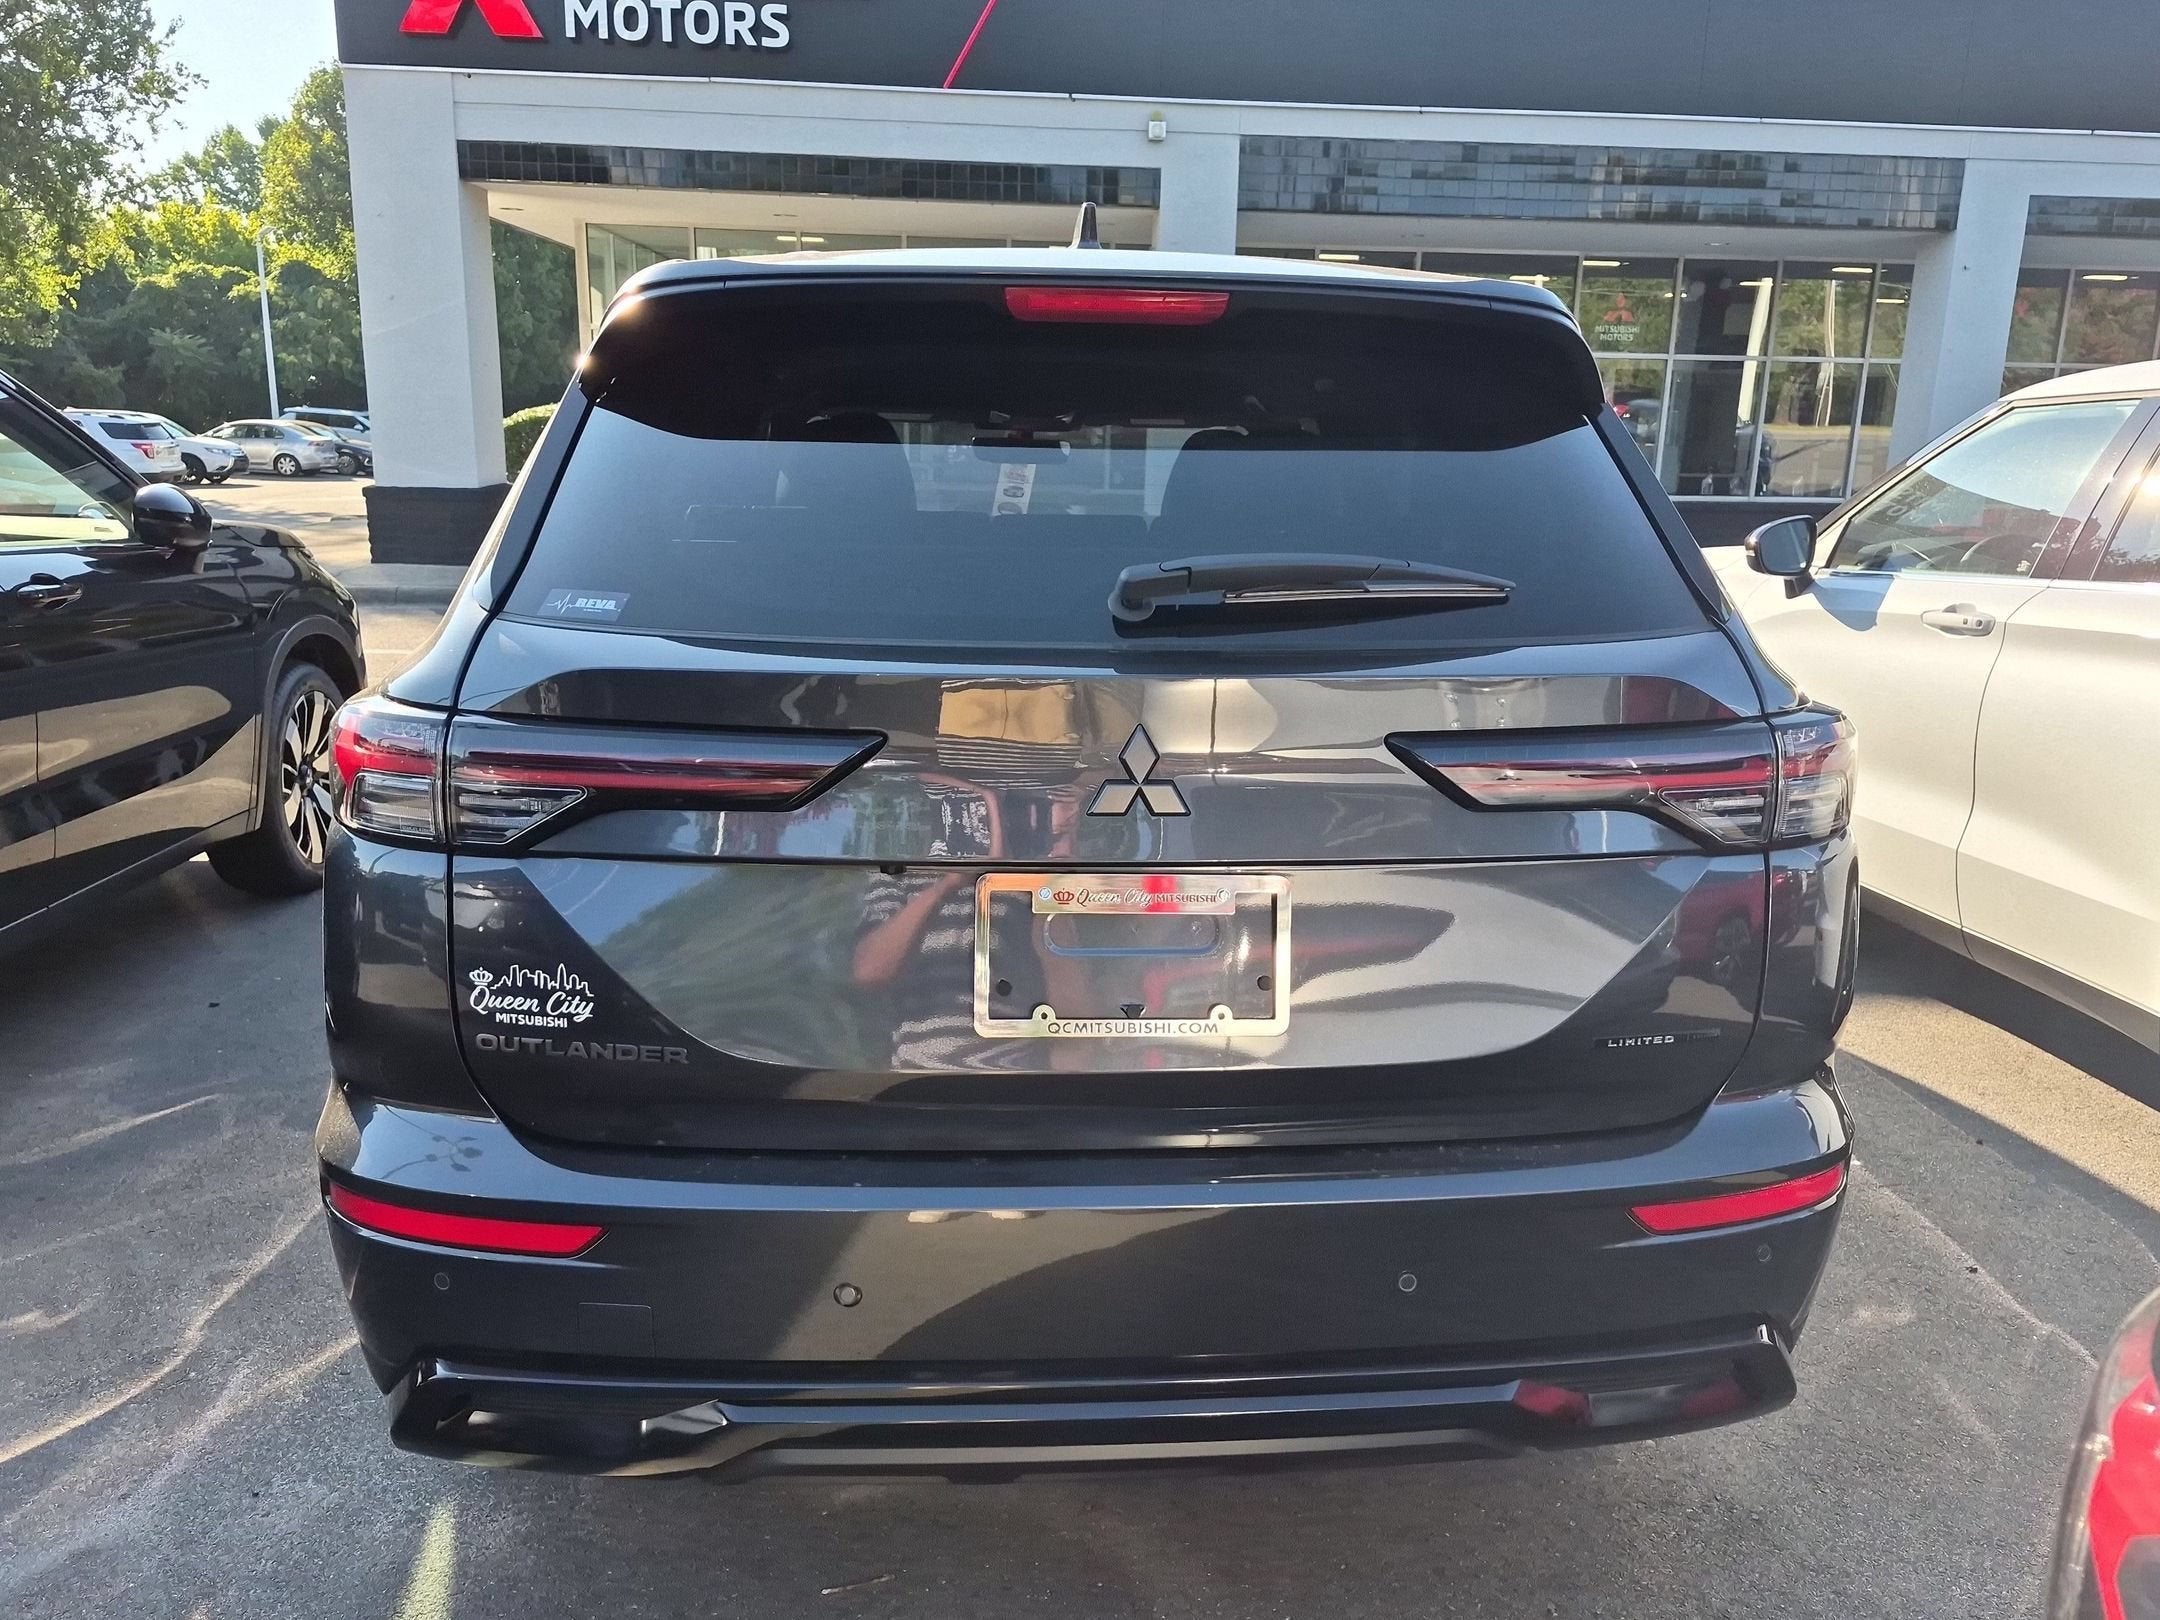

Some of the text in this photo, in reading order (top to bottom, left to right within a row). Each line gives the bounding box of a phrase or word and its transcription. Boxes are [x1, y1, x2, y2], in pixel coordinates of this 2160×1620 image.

[565, 0, 790, 48] MOTORS
[1599, 333, 1634, 341] MOTORS
[576, 598, 617, 608] REVA
[1076, 888, 1216, 907] Queen City MITSUBISHI
[469, 986, 594, 1022] Queen City
[496, 1013, 568, 1028] MITSUBISHI
[1048, 1022, 1218, 1034] QCMITSUBISHI.COM
[1608, 1036, 1674, 1047] LIMITED
[476, 1034, 688, 1065] OUTLANDER
